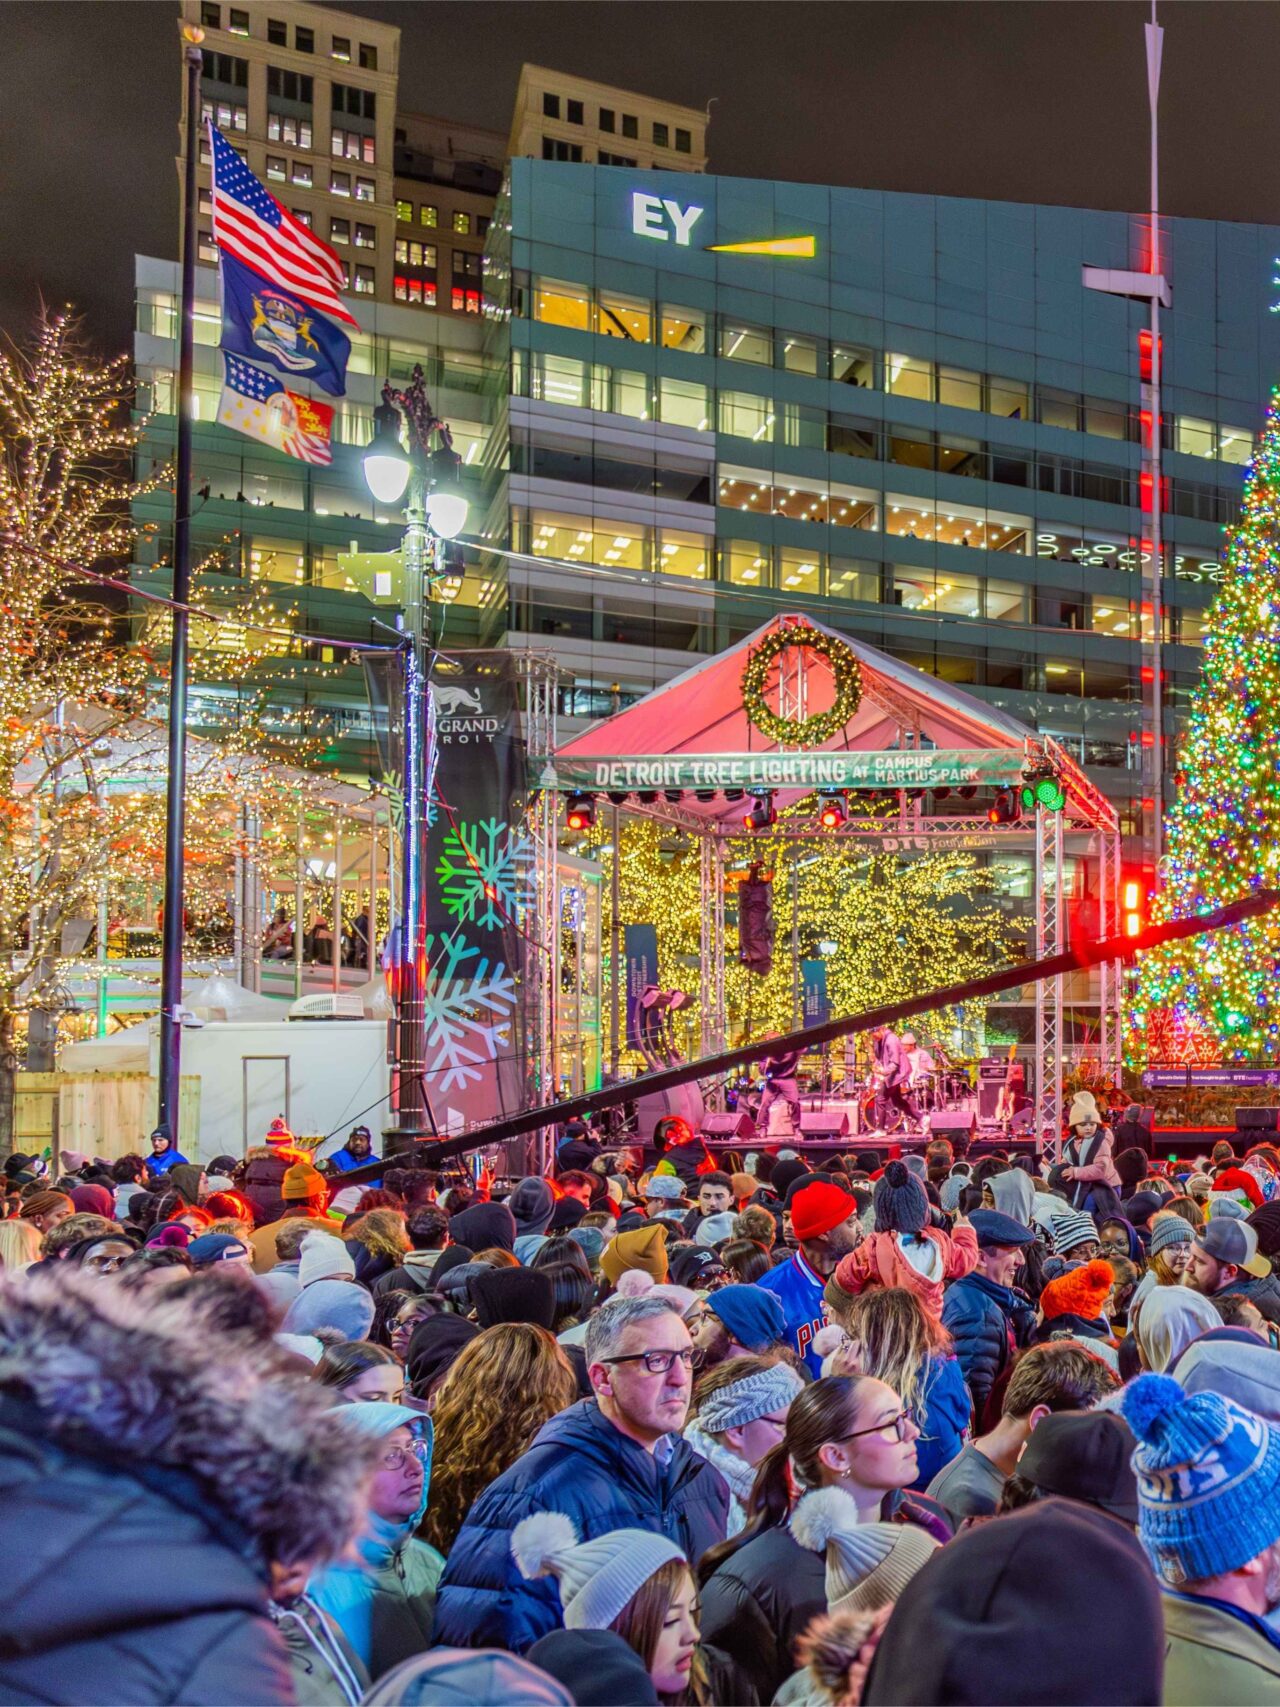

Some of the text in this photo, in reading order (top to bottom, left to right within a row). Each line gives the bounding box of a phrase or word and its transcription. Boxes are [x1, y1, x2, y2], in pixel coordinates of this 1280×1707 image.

[633, 192, 704, 246] EY
[439, 719, 498, 733] GRAND
[875, 756, 933, 770] CAMPUS
[596, 758, 869, 786] DETROIT TREE LIGHTING AT
[875, 768, 979, 782] MARTIUS PARK
